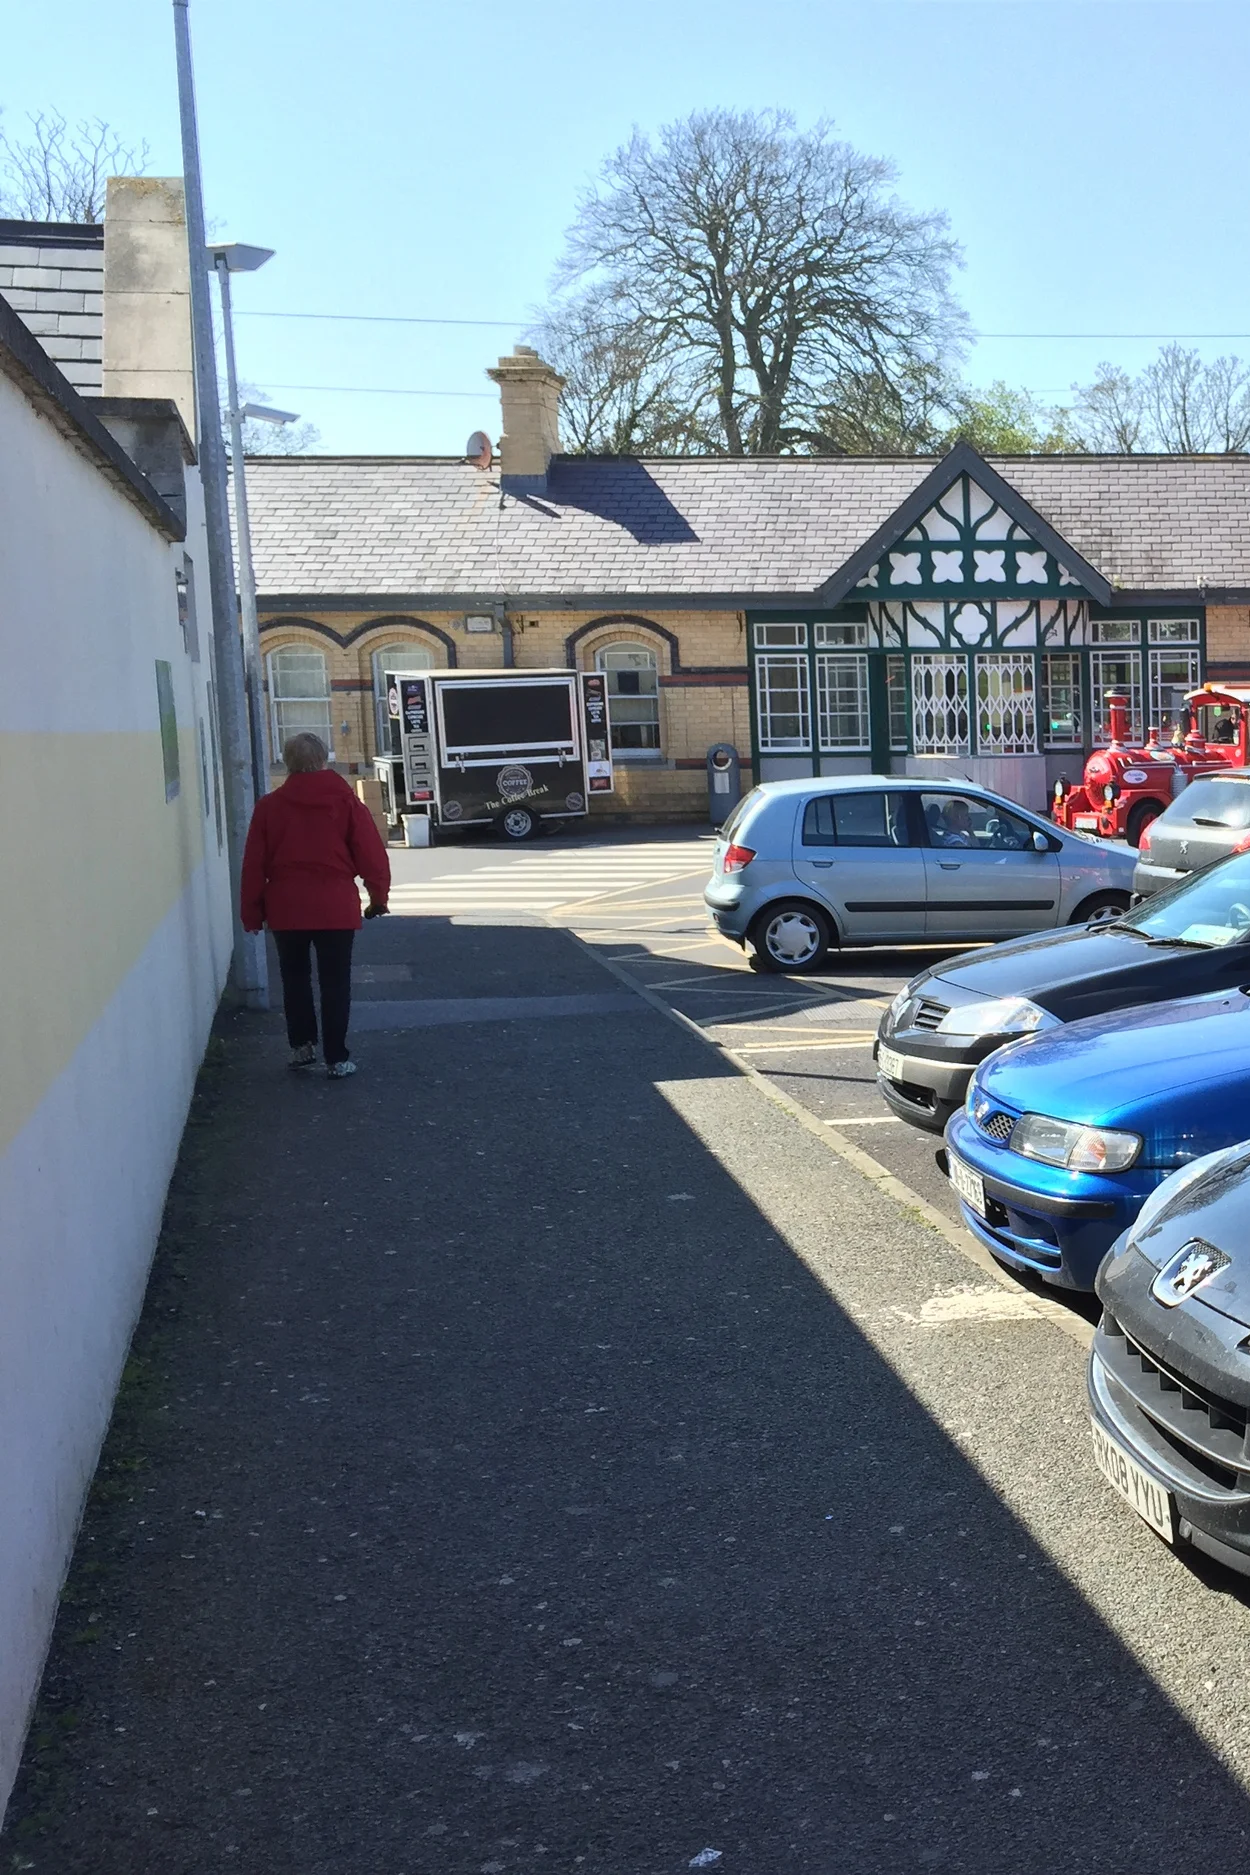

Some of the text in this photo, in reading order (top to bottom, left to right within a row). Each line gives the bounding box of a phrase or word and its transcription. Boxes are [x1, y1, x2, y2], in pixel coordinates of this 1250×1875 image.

[502, 779, 528, 787] COFFEE
[485, 784, 550, 810] The Coffee Break
[1130, 1465, 1164, 1528] YYU
